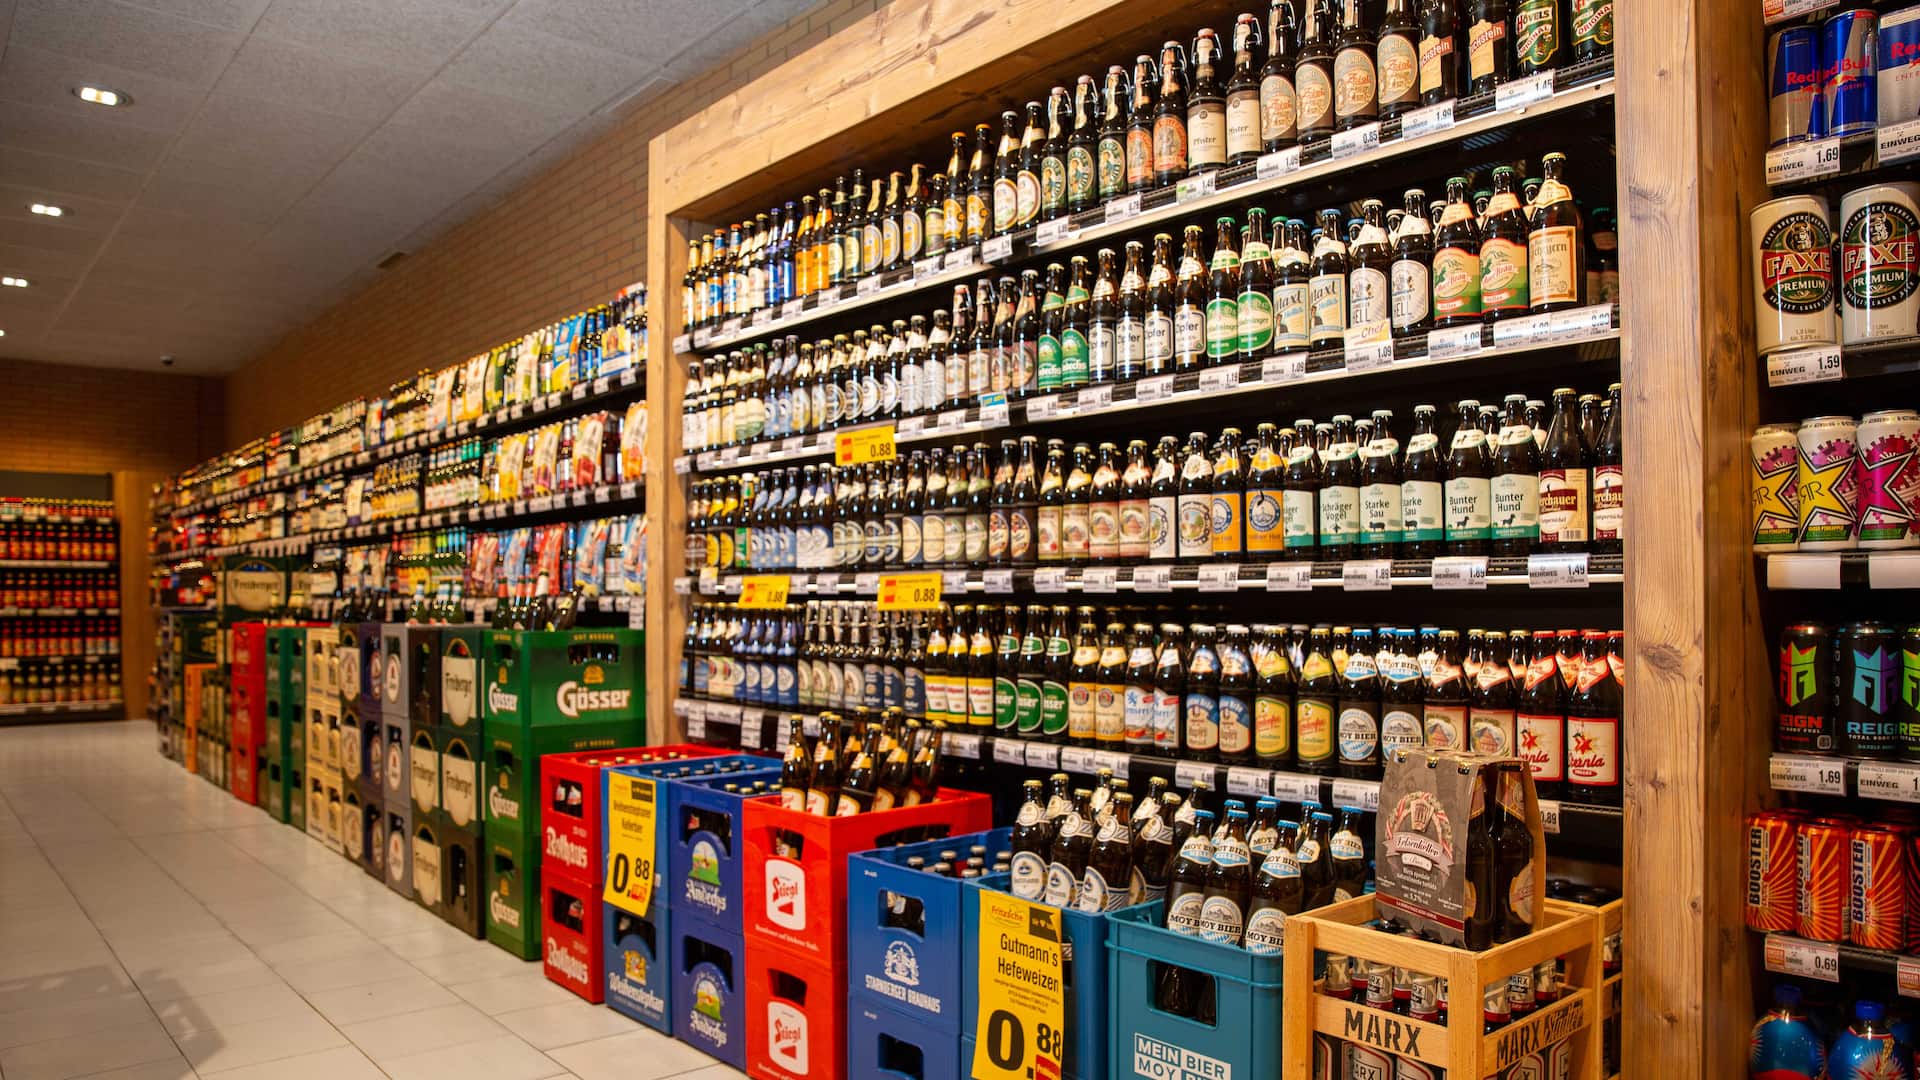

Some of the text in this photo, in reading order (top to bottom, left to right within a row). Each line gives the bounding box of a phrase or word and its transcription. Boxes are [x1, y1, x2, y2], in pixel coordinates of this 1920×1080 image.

[1517, 7, 1551, 31] HÖVELS
[1840, 55, 1871, 73] Bull
[1815, 146, 1839, 165] 1.69
[1768, 161, 1804, 174] EINWEG
[1844, 240, 1916, 273] FAXE
[1766, 252, 1831, 278] FAXE
[1779, 279, 1827, 292] PREMIUM
[1853, 271, 1905, 287] PREMIUM
[1817, 354, 1840, 371] 1.59
[870, 442, 891, 457] 0.88
[1364, 499, 1390, 510] Starke
[1449, 496, 1478, 506] Bunter
[1495, 492, 1525, 504] Bunter
[1369, 508, 1384, 518] Sau
[1451, 504, 1475, 514] Hund
[1497, 501, 1521, 512] Hund
[1325, 510, 1347, 522] Vogel
[1567, 563, 1585, 576] 1.49
[914, 588, 936, 602] 0.88
[488, 681, 518, 713] Gösser
[556, 680, 631, 717] Gösser
[1354, 732, 1377, 740] BIER
[1399, 736, 1422, 744] BIER
[1819, 769, 1841, 784] 1.69
[1749, 827, 1763, 907] BOOSTER
[772, 876, 799, 900] Stiegl
[1852, 841, 1865, 923] BOOSTER
[1169, 914, 1191, 924] MOY
[1217, 924, 1241, 934] BIER
[1247, 931, 1267, 943] MOY
[1814, 954, 1838, 972] 0.69
[997, 956, 1060, 993] Hefeweizen
[775, 1018, 801, 1043] Stiegl
[1344, 1006, 1422, 1057] MARX
[1496, 1023, 1540, 1068] MARX
[1137, 1037, 1225, 1079] MEIN BIER
[1138, 1057, 1176, 1080] MOY
